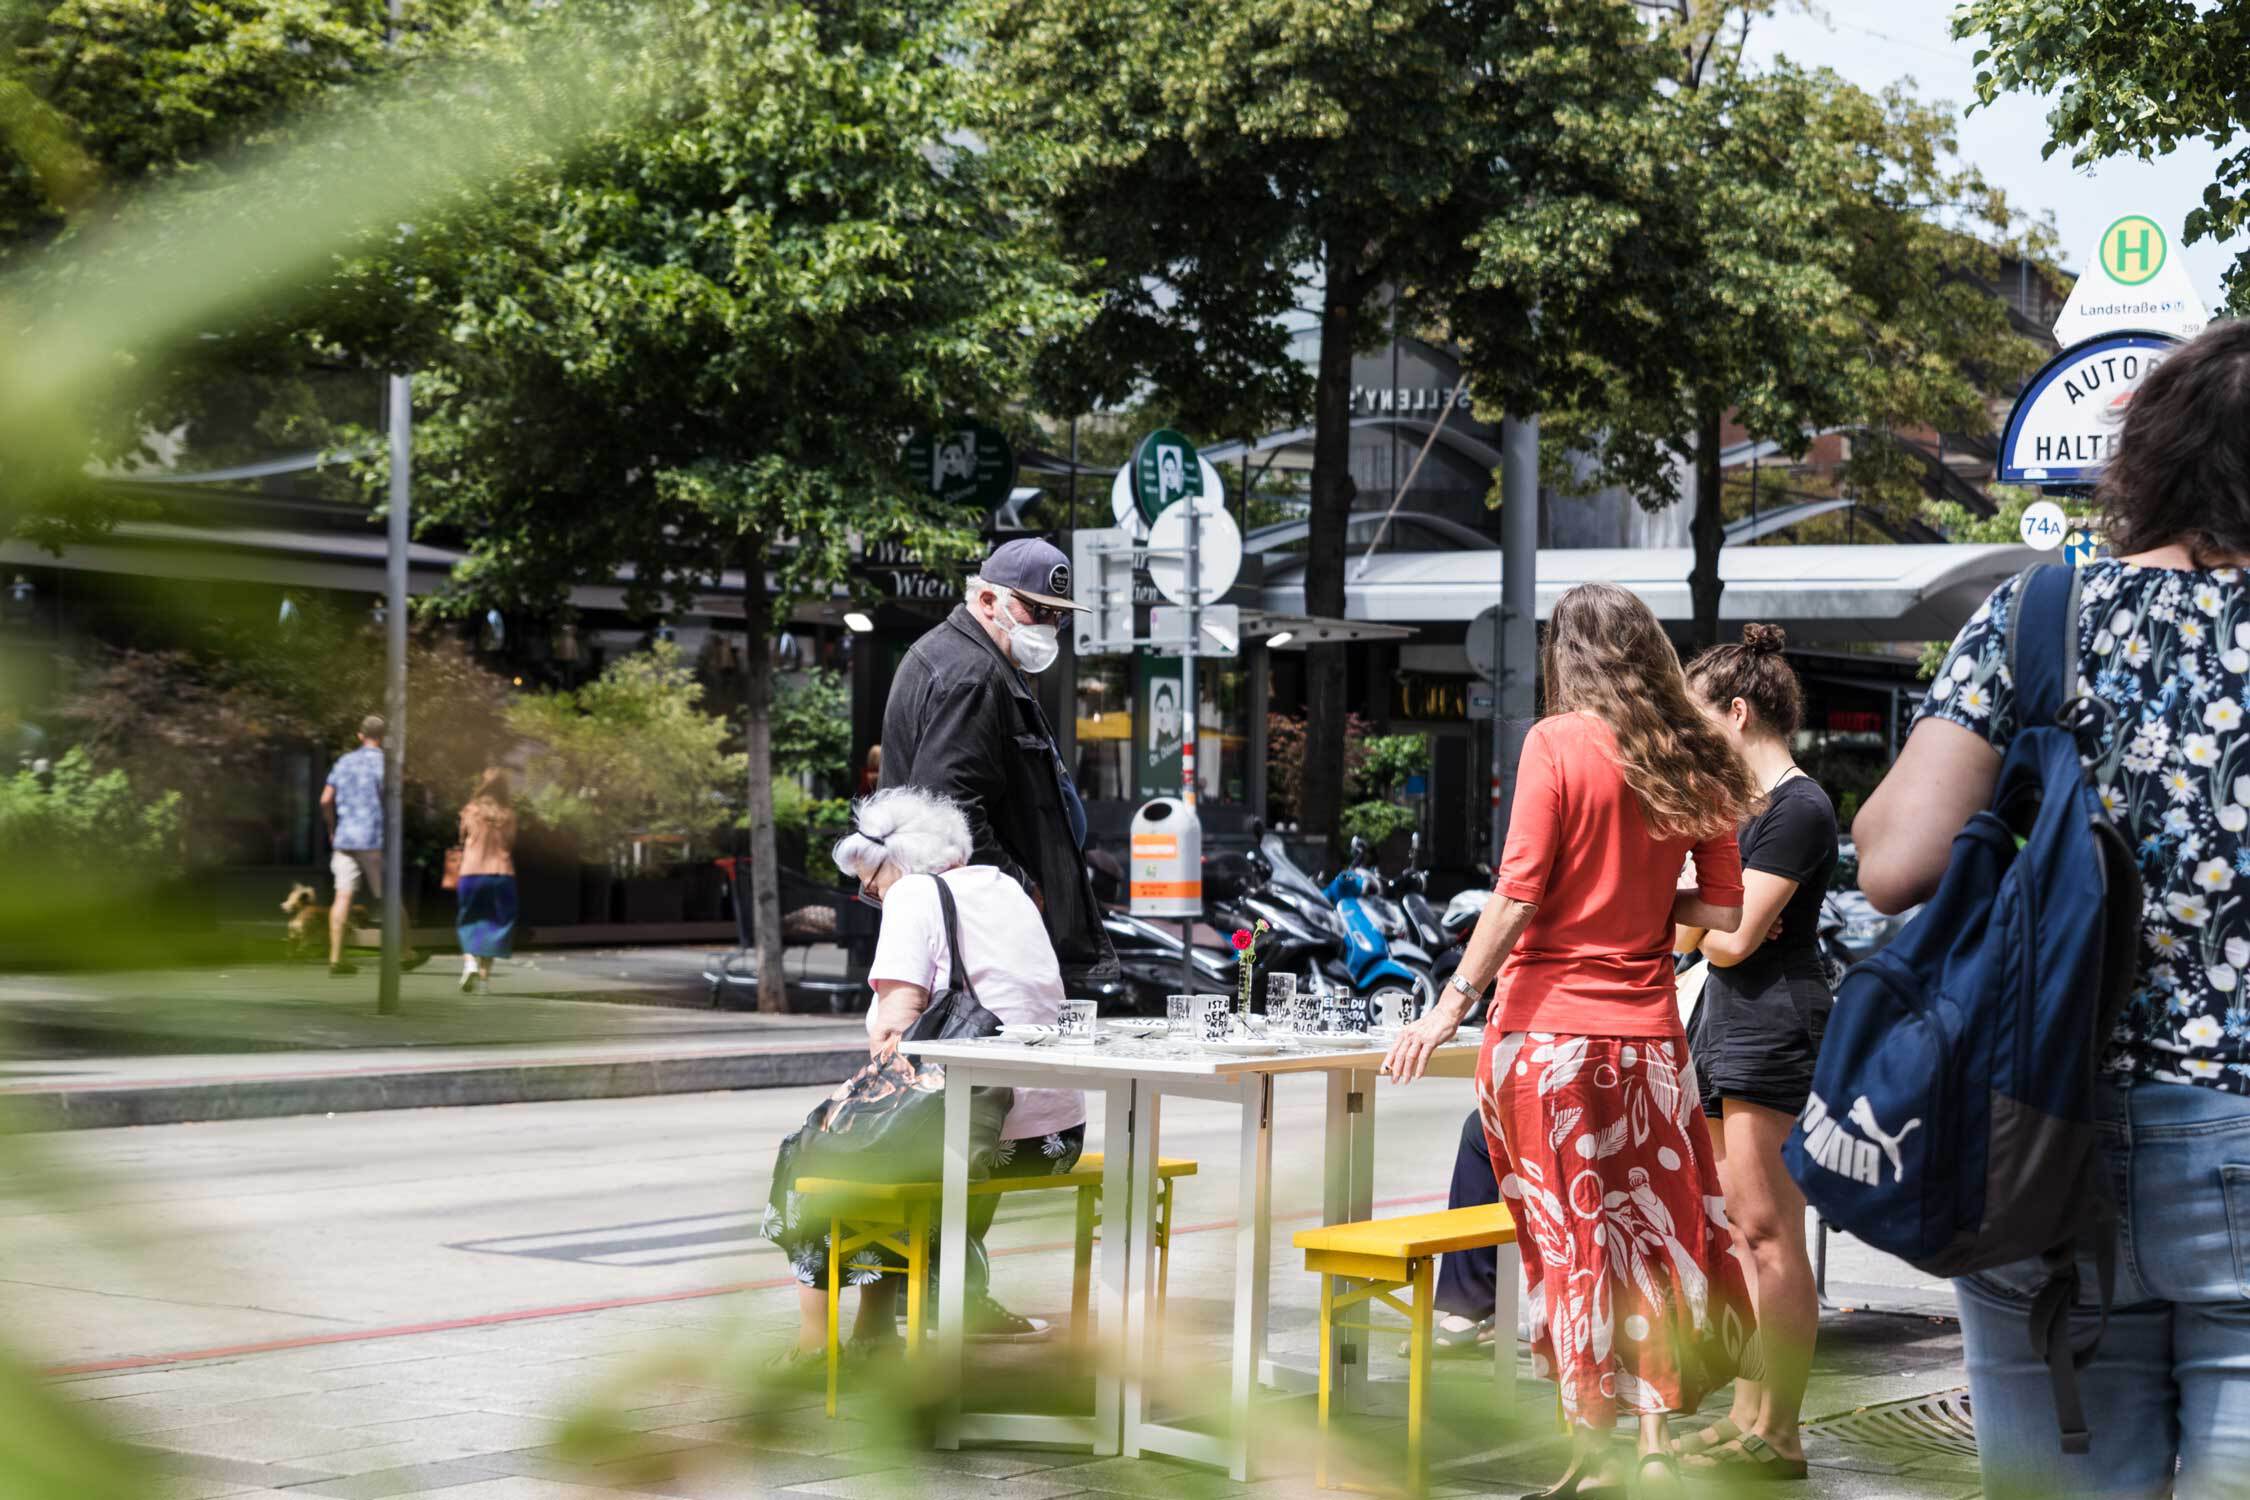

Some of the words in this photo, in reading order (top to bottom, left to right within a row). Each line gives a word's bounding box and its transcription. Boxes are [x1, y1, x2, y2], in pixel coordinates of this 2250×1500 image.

[2116, 228, 2149, 272] H
[2080, 301, 2157, 317] Landstraße
[2025, 517, 2060, 535] 74A
[1803, 1091, 1880, 1187] PUMA
